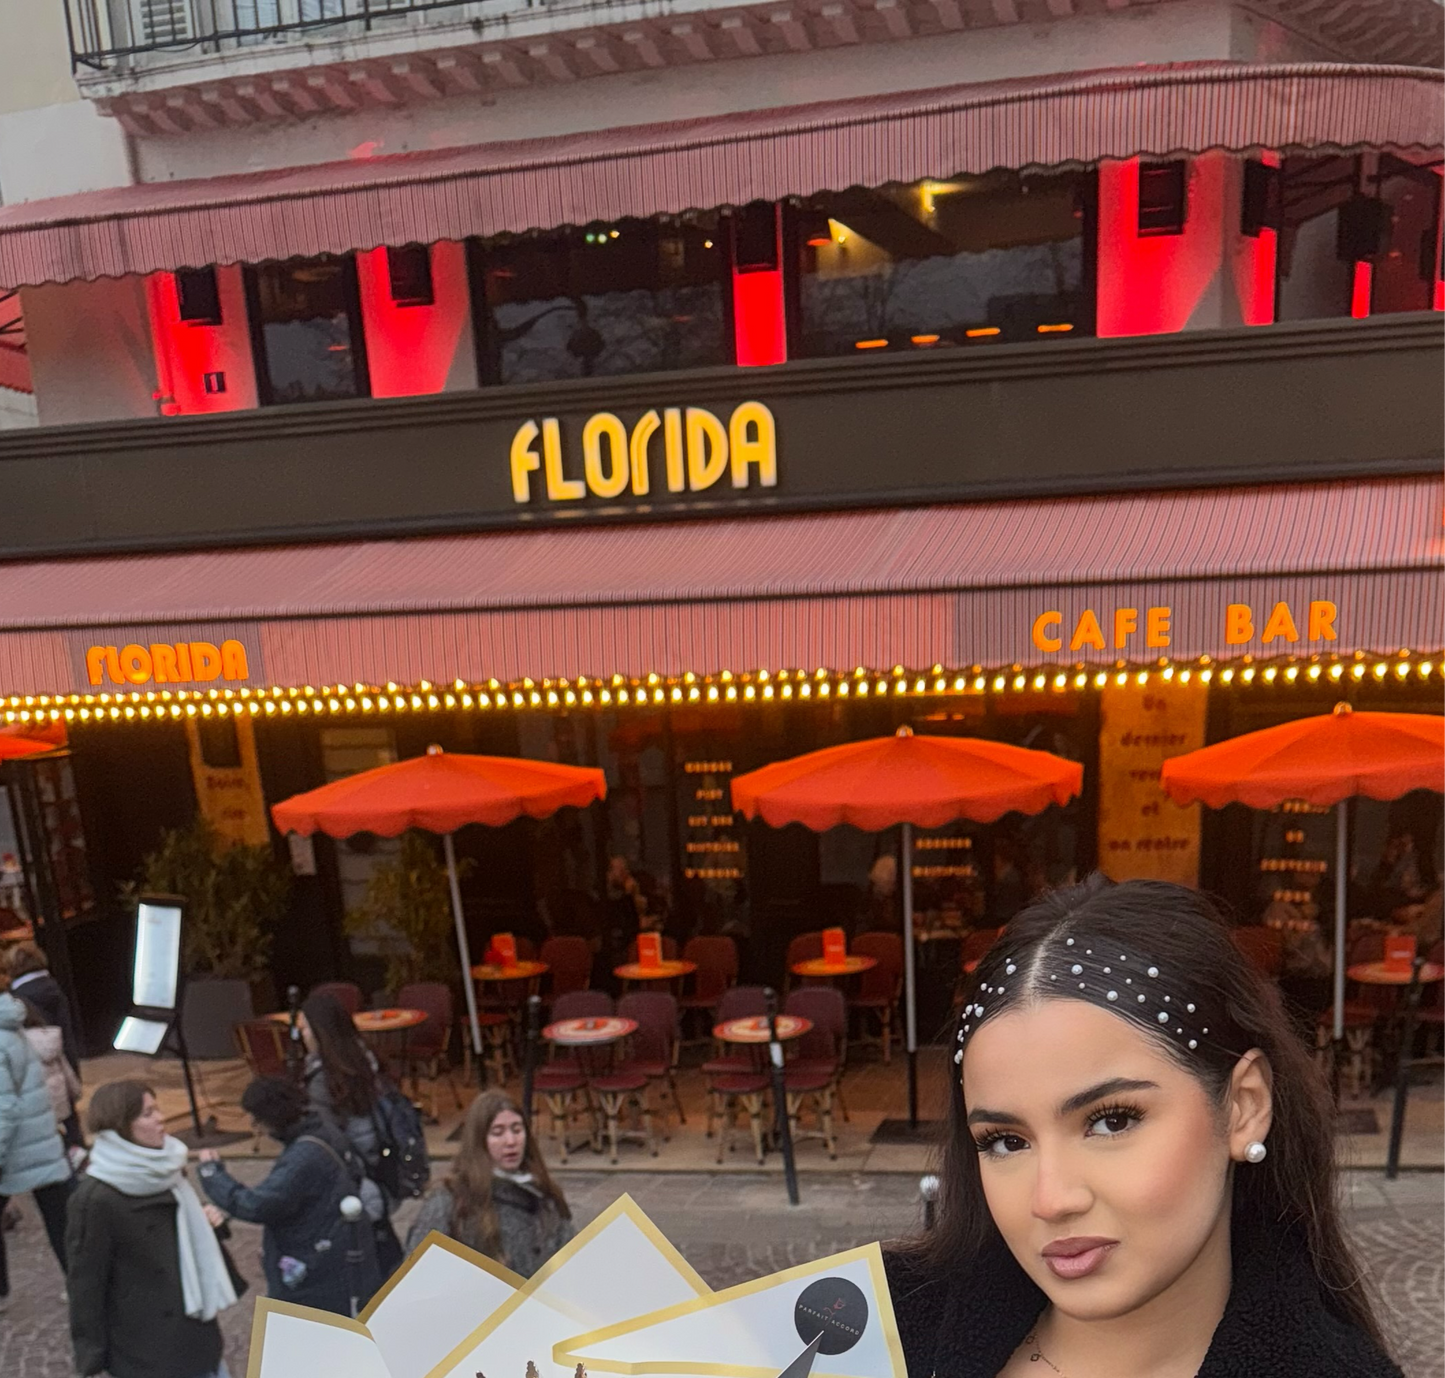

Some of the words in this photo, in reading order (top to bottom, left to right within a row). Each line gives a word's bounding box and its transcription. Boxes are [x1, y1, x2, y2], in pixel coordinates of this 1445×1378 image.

[510, 401, 777, 503] FLORIDA
[1032, 607, 1172, 652] CAFE
[1226, 601, 1338, 645] BAR
[86, 639, 249, 686] FLORIDA
[798, 1304, 829, 1322] PARFAIT
[831, 1319, 860, 1337] ACCORD
